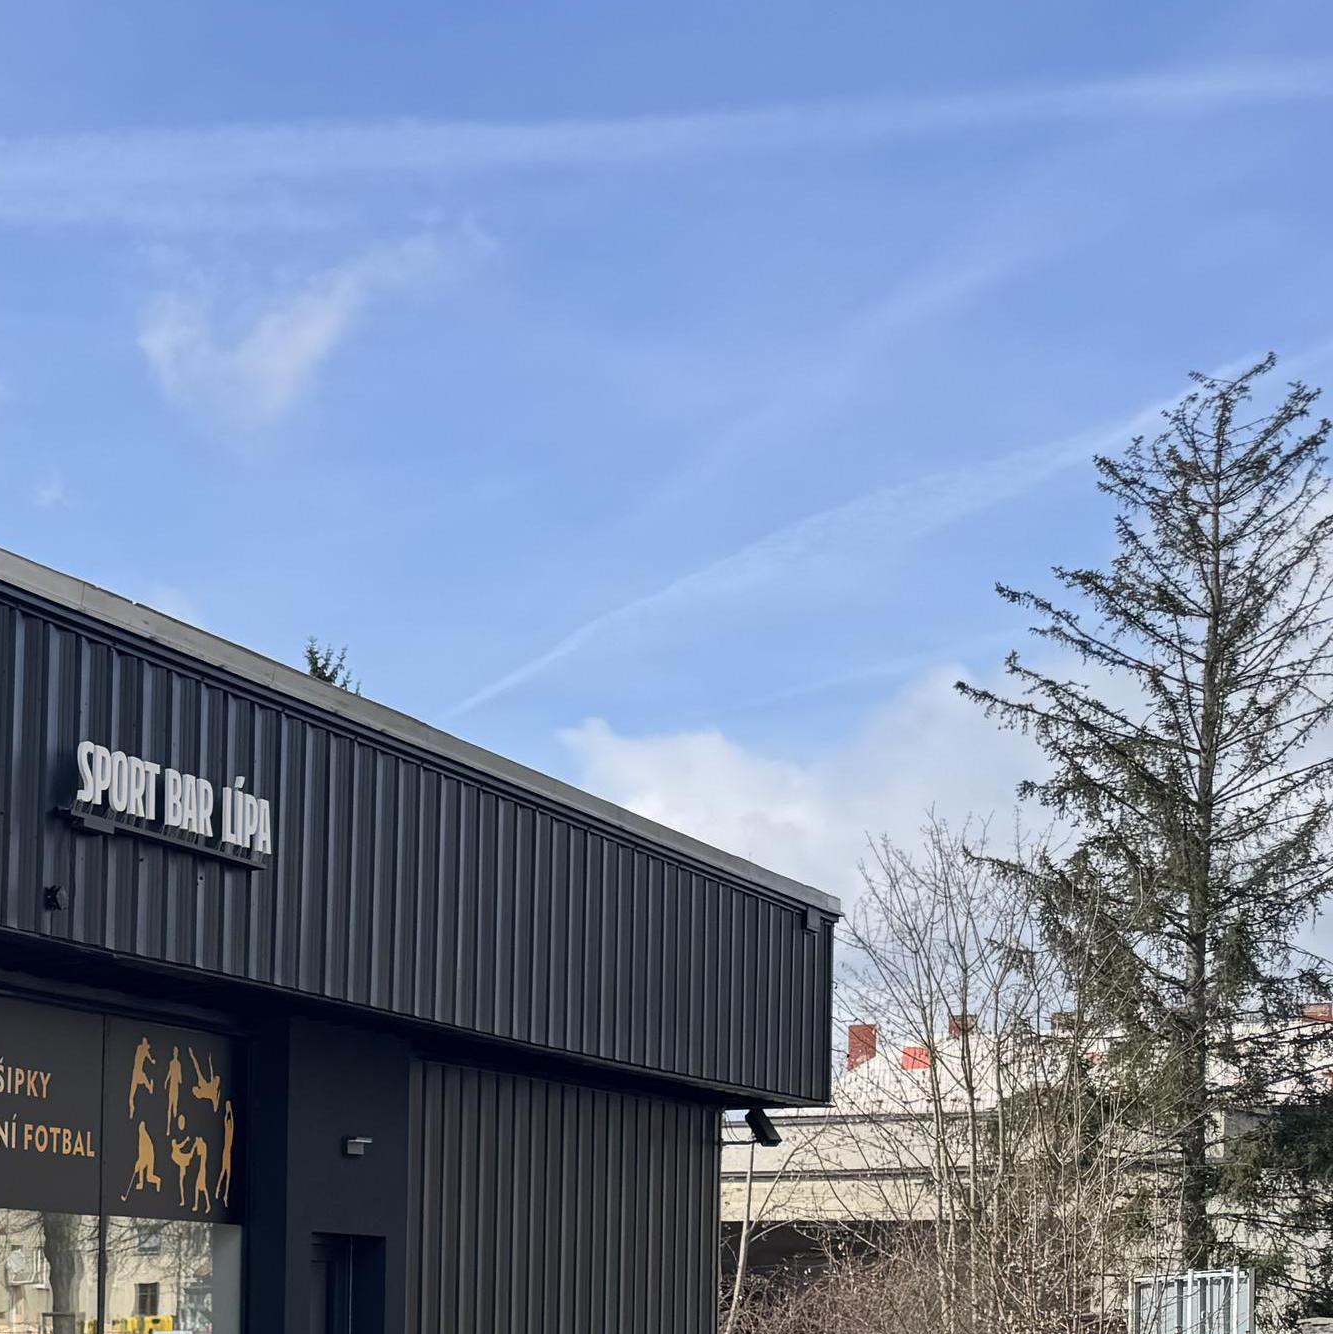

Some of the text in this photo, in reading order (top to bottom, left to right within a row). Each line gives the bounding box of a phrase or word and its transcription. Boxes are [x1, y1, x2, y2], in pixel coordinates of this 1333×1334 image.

[76, 740, 272, 855] SPORT BAR LÍPA
[23, 1123, 96, 1158] FOTBAL
